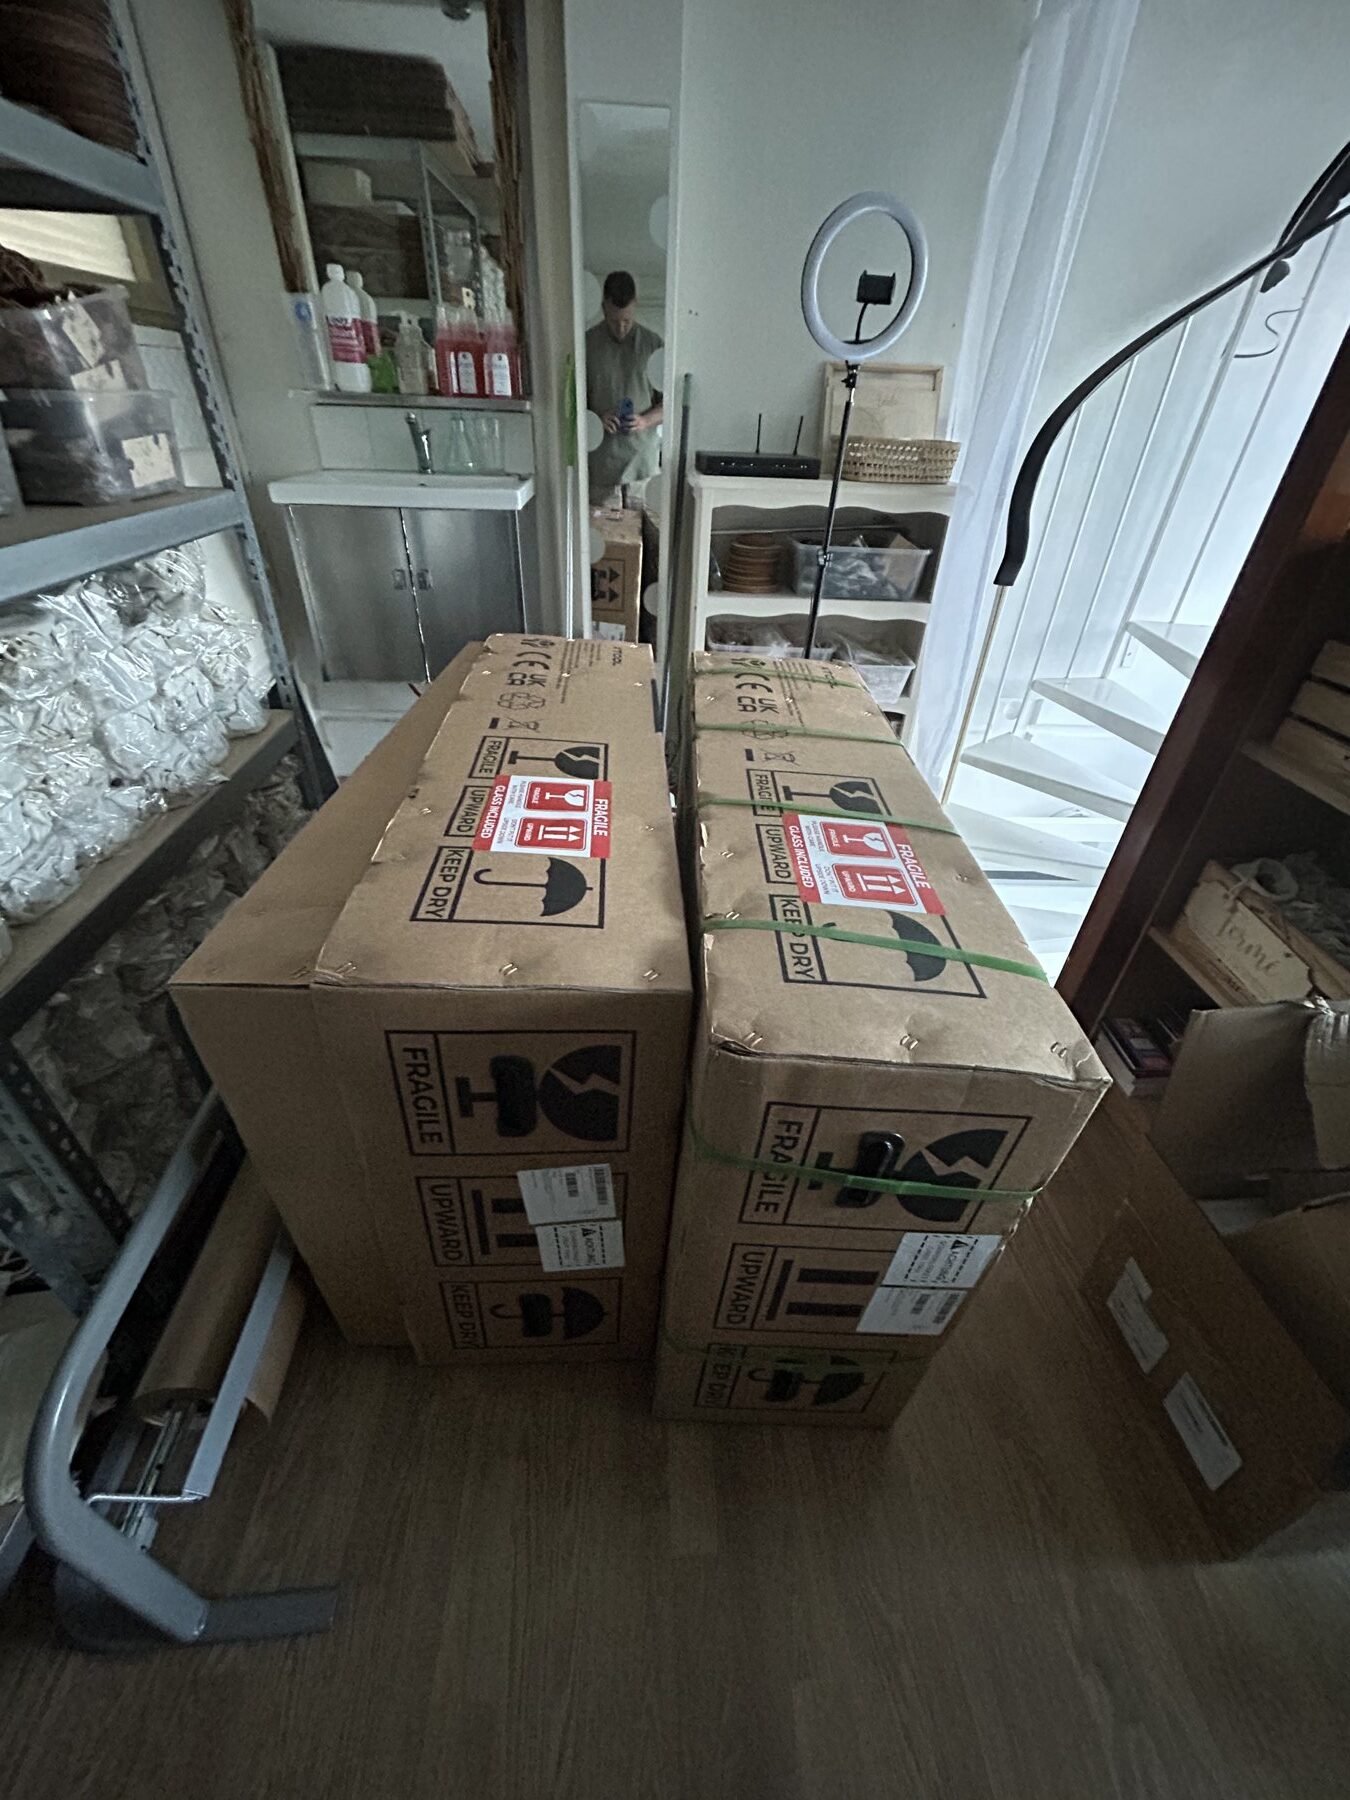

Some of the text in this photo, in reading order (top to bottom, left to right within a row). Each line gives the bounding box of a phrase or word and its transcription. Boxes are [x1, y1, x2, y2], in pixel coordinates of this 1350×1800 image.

[507, 671, 527, 687] CA
[526, 673, 549, 688] UK
[737, 695, 757, 713] CA
[757, 697, 780, 714] UK
[479, 740, 502, 774] FRAGILE
[456, 789, 486, 833] UPWARD
[480, 785, 506, 839] GLASS INCLUDED
[755, 773, 776, 812] FRAGIE
[593, 798, 609, 837] FRAGILE
[765, 828, 791, 879] UPWARD
[789, 825, 814, 888] GLASS INCLUDED
[896, 843, 932, 889] FRAGILE
[425, 849, 465, 918] KEEP DRY
[789, 942, 815, 979] DRY
[402, 1046, 443, 1145] FRAGILE
[428, 1183, 463, 1262] UPWARD
[450, 1284, 475, 1318] KEEP
[726, 1250, 762, 1327] UPWARD
